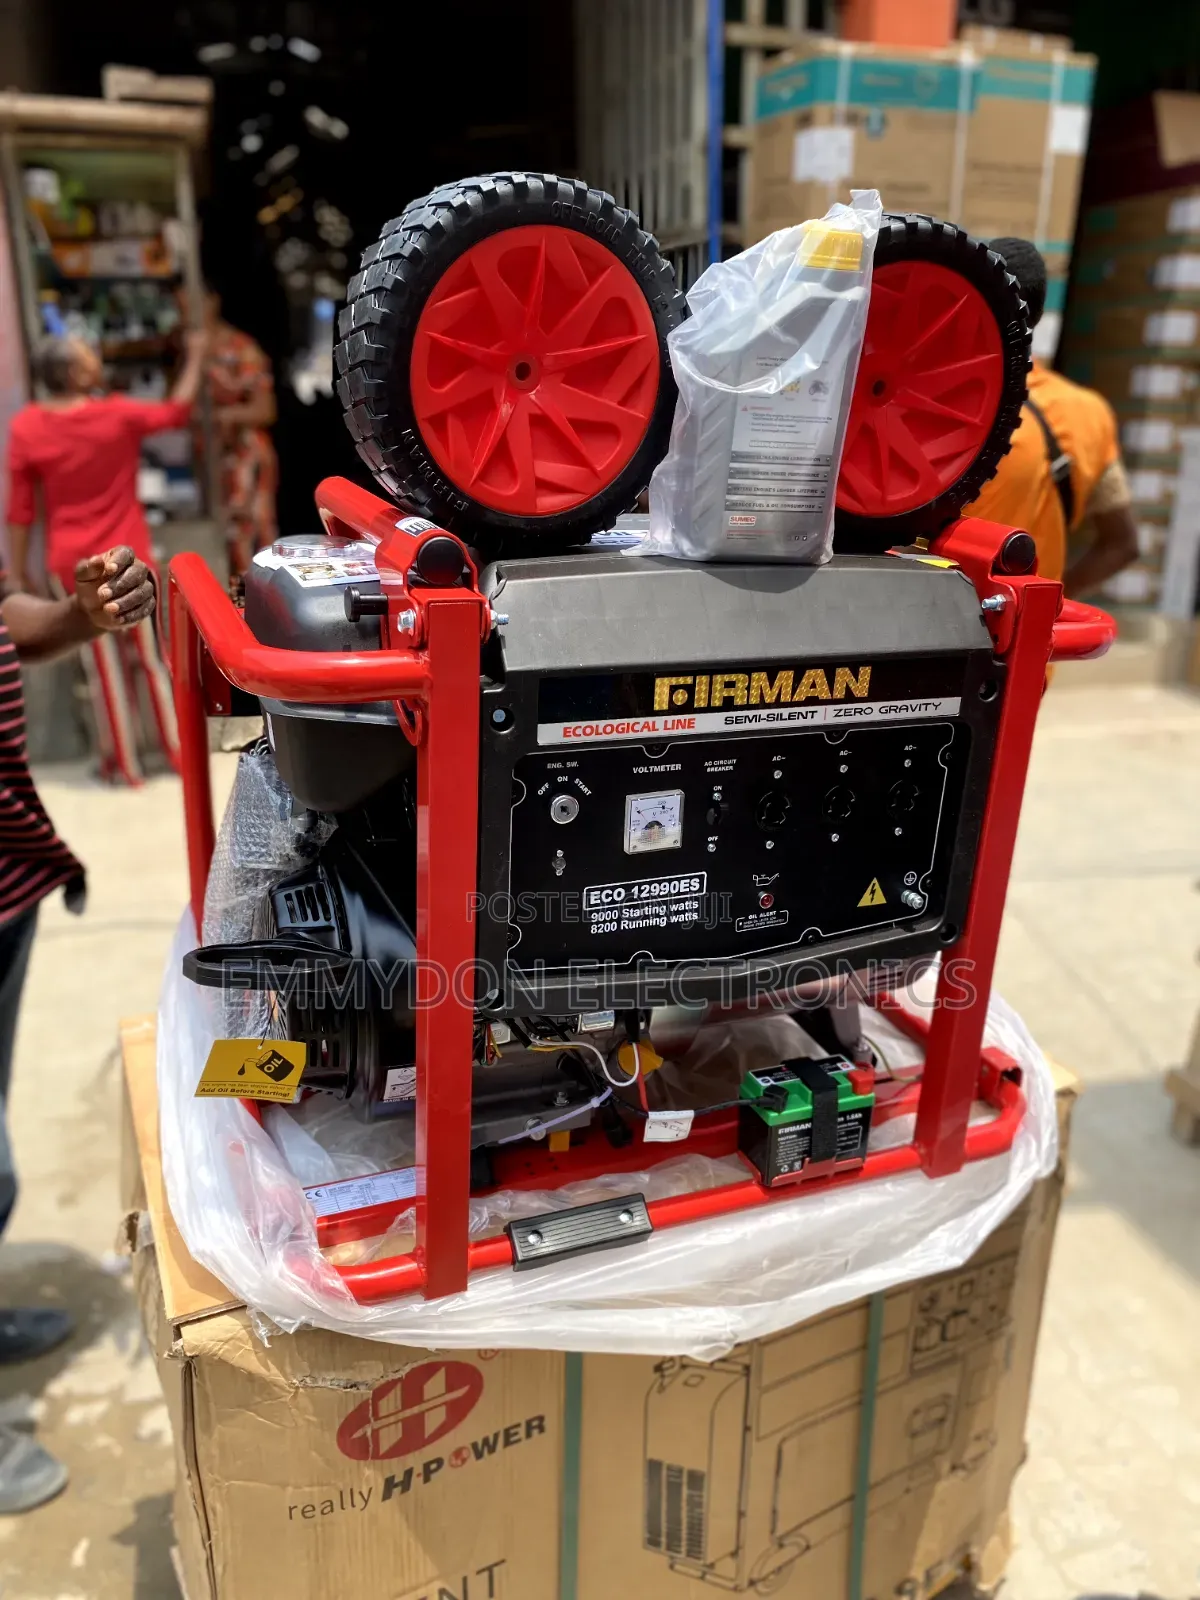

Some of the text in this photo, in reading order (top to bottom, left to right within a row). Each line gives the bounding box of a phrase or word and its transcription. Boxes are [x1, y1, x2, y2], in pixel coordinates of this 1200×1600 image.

[401, 428, 469, 511] FIRMAN
[653, 666, 872, 711] FIRMAN
[562, 702, 942, 738] ECOLOGICAL LINE SEMI-SILENT ZERO GRAVITY
[632, 763, 682, 774] VOLTMETER
[706, 765, 734, 773] BREAKER
[713, 758, 737, 766] CIRCUIT
[557, 775, 569, 783] ON
[537, 782, 550, 796] OFF
[574, 778, 592, 796] START
[590, 878, 700, 905] ECO 12990ES
[591, 900, 699, 923] 9000 Starting watts
[759, 910, 777, 918] ALERT
[590, 912, 699, 934] 8200 Running watts
[264, 1058, 283, 1073] OIL
[257, 1089, 291, 1097] Starting!
[778, 1122, 812, 1134] FIRMAN
[288, 1486, 373, 1521] really
